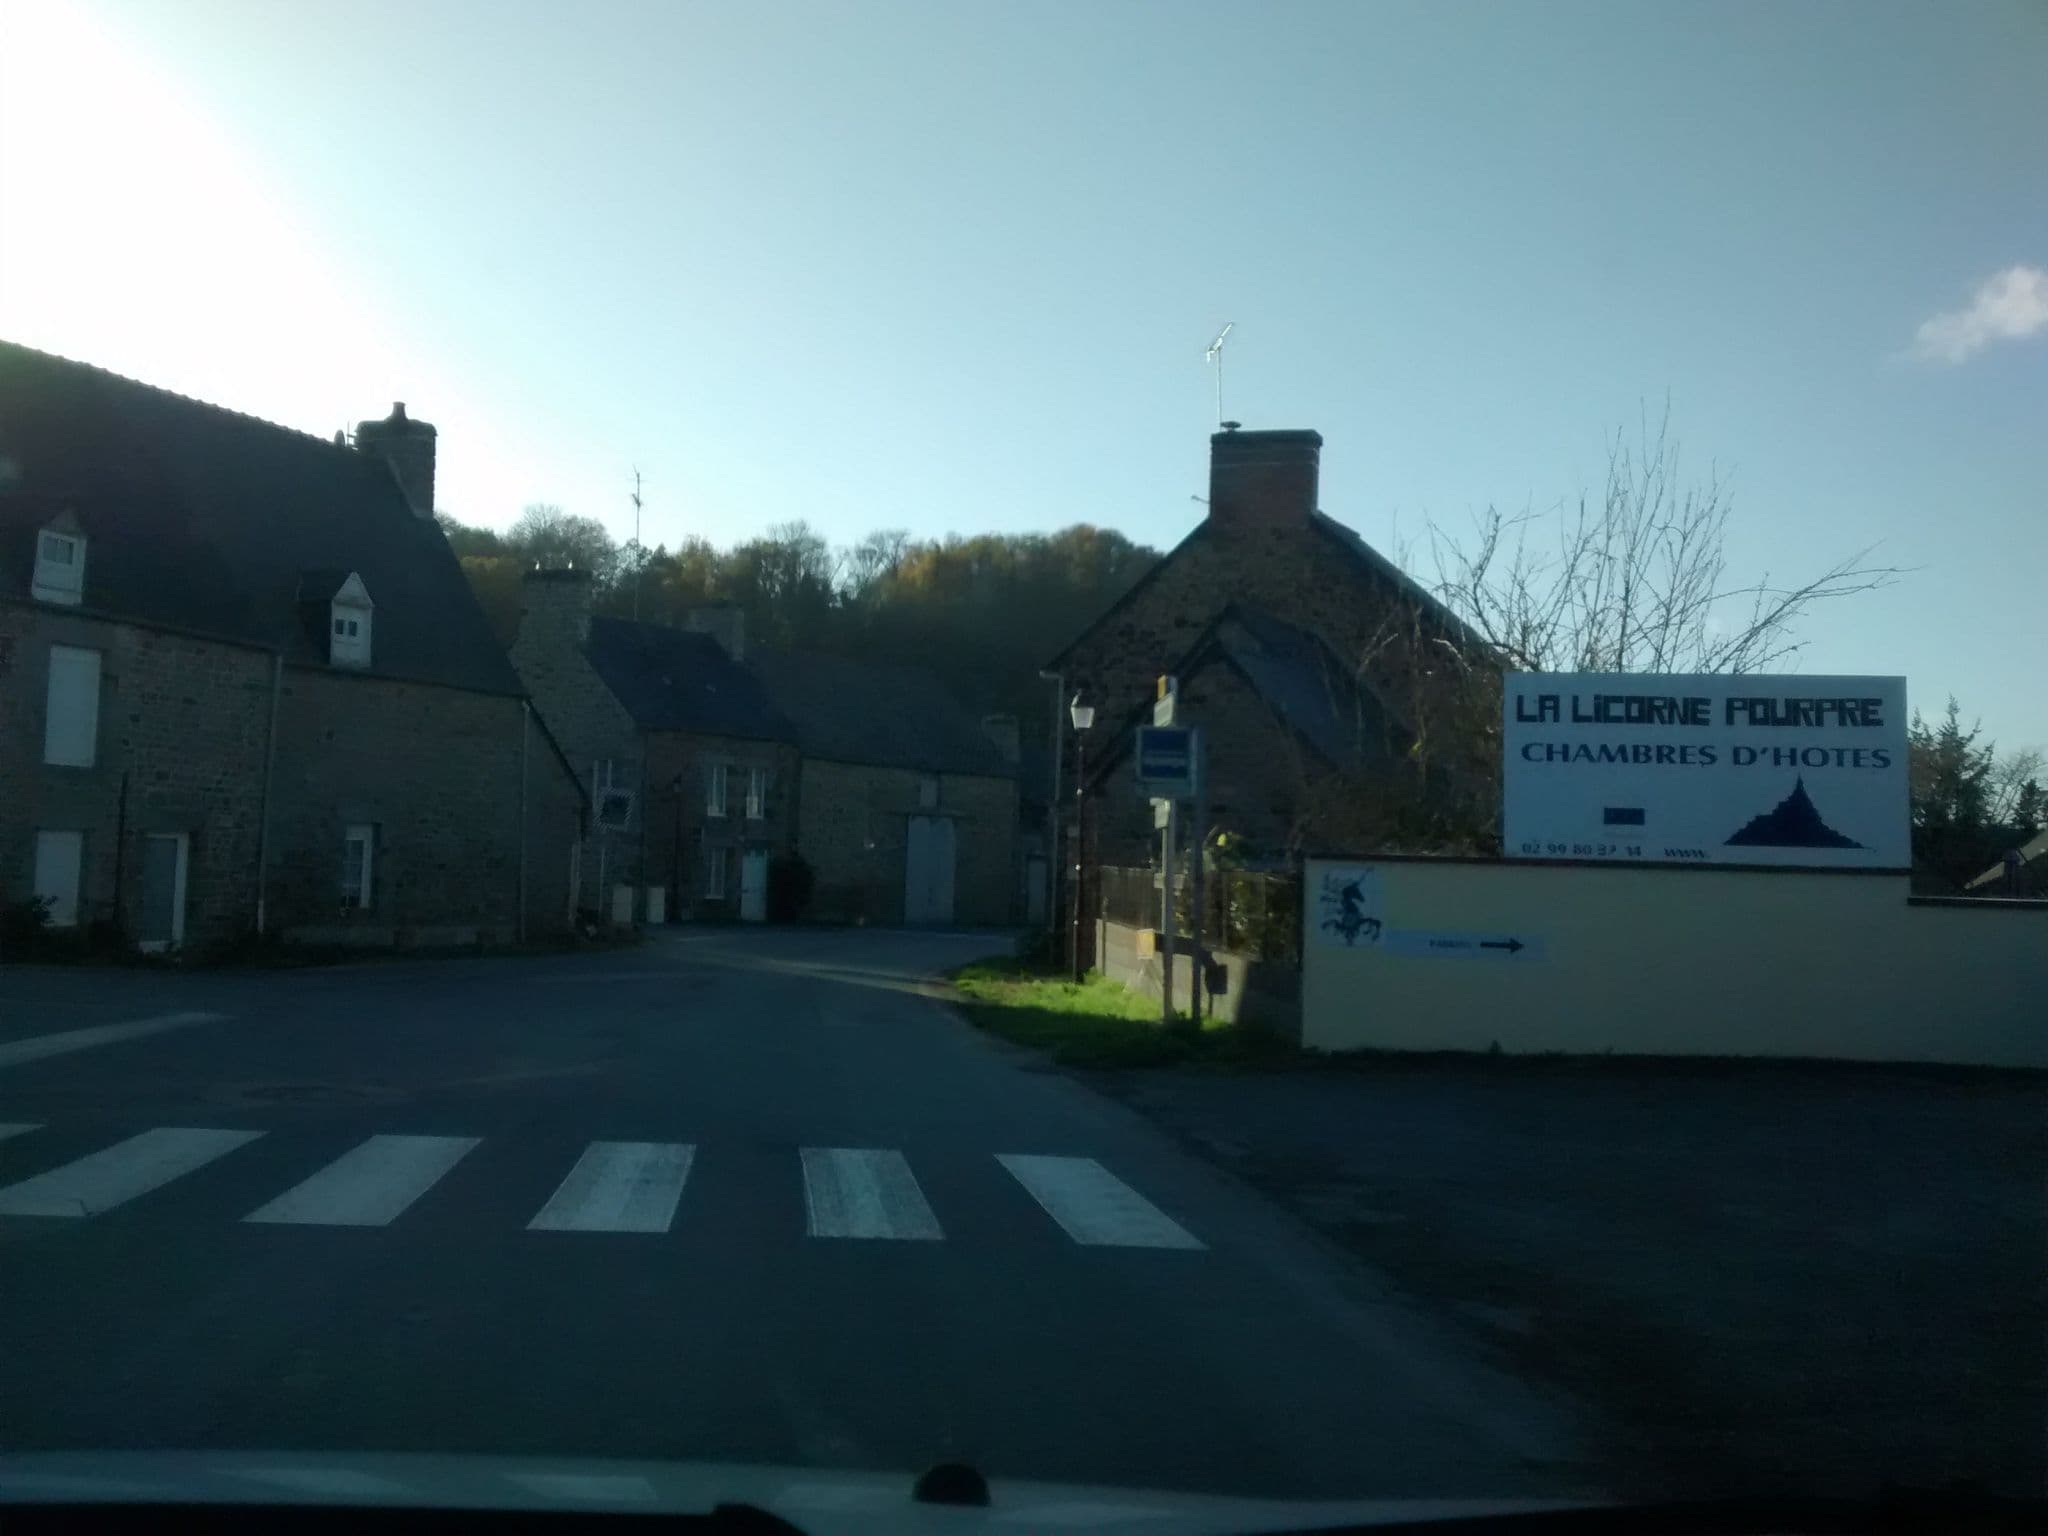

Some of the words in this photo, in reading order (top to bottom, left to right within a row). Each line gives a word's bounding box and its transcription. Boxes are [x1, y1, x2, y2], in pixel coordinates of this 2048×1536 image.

[1517, 694, 1560, 723] LA
[1572, 694, 1712, 726] LICORNE
[1726, 697, 1884, 728] POURPRE
[1521, 742, 1718, 767] CHAMBRES
[1733, 746, 1892, 769] D'HOTES
